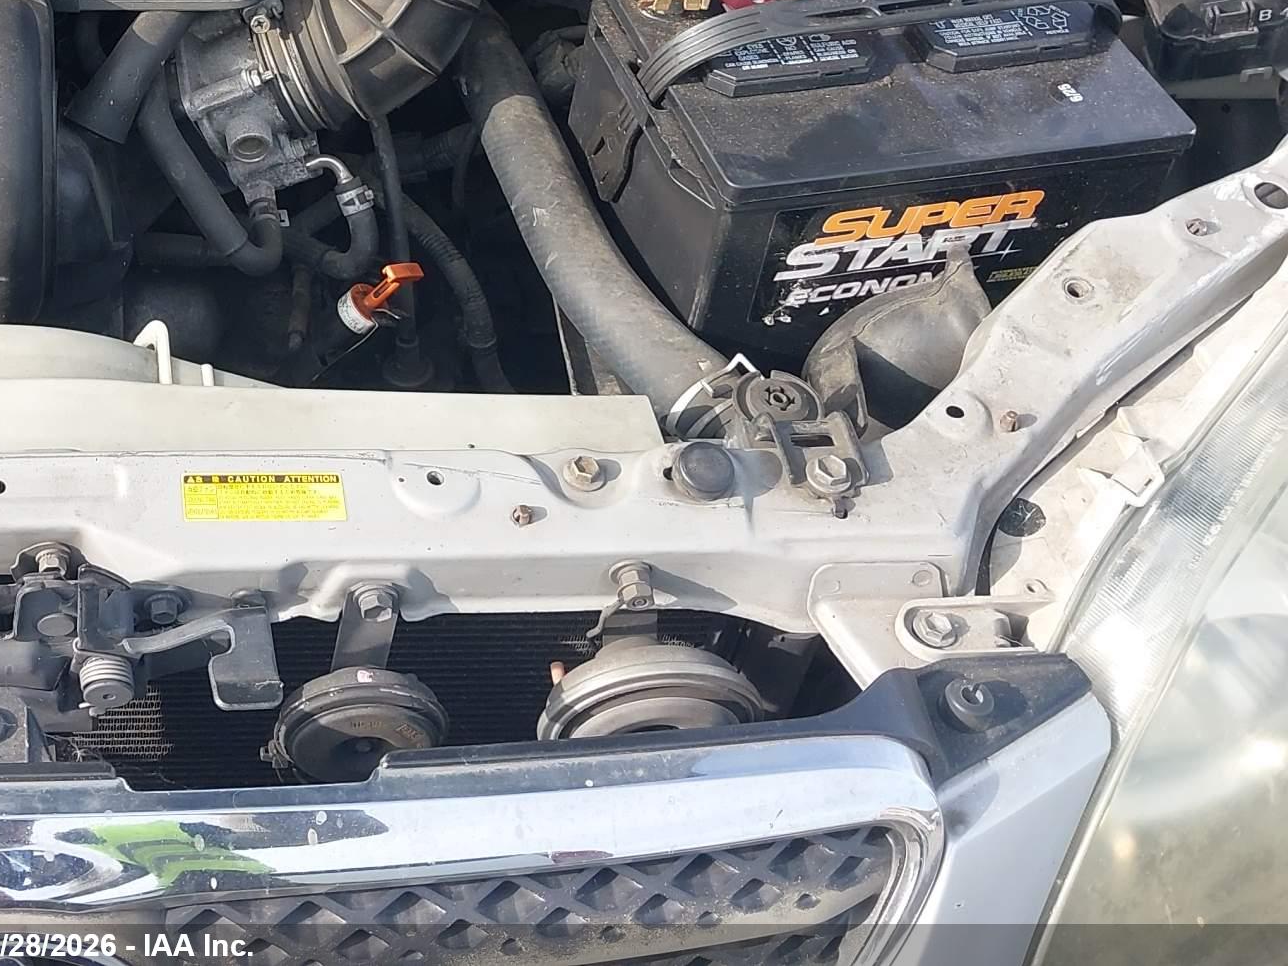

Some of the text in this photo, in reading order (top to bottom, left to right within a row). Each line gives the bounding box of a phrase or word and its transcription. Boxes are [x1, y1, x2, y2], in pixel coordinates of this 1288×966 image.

[1057, 83, 1084, 103] 6/25
[813, 189, 1046, 246] SUPER
[773, 218, 1036, 282] START
[227, 475, 276, 483] CAUTION
[284, 475, 338, 483] ATTENTION
